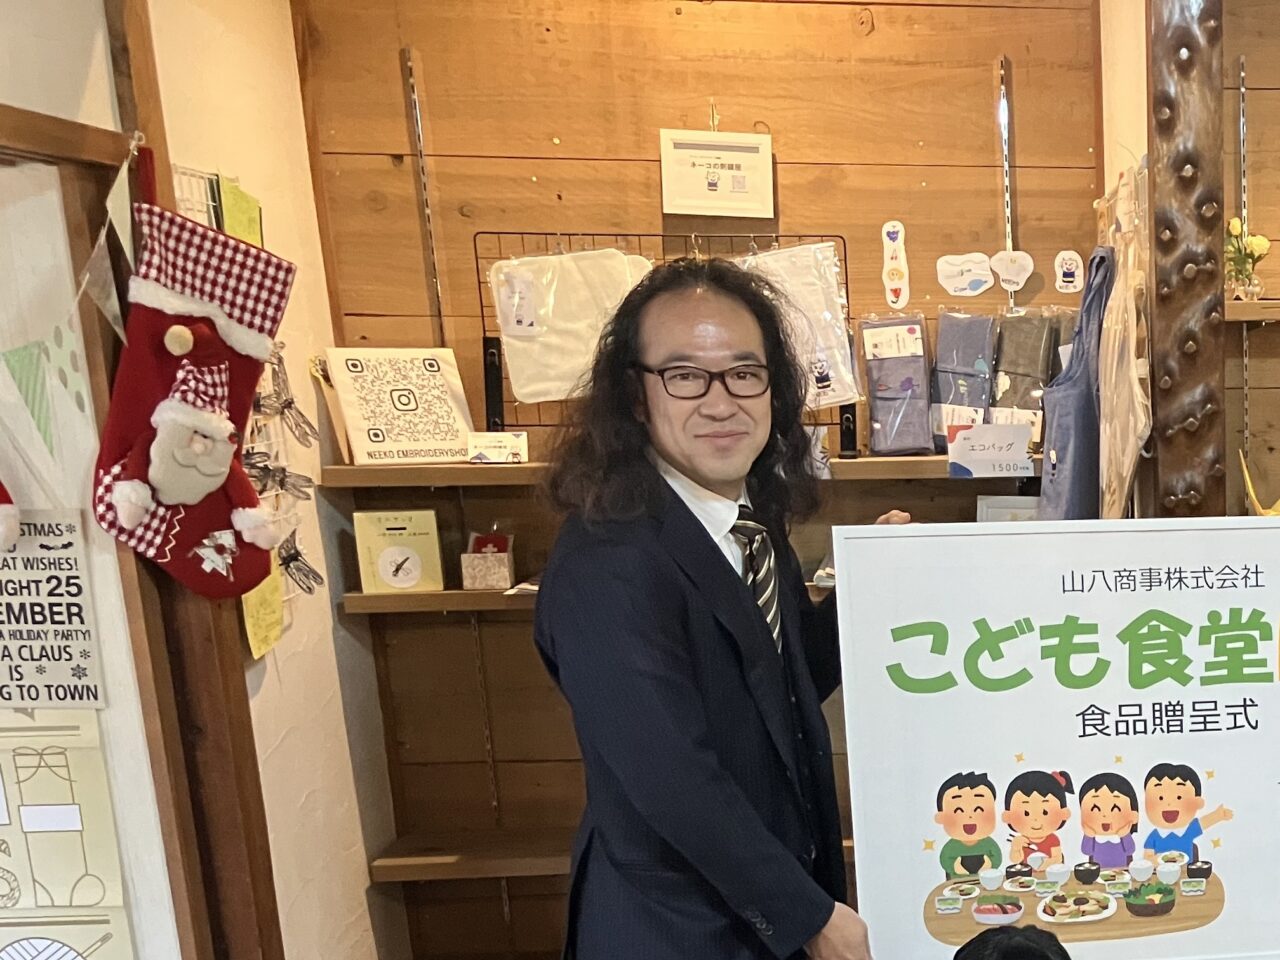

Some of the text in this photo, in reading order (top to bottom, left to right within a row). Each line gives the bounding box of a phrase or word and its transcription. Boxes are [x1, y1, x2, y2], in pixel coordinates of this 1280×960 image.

[366, 450, 395, 459] NEEKO
[397, 448, 469, 458] EMBROIDERYSHO
[969, 442, 1014, 452] エコバッグ
[22, 557, 79, 571] WISHES!
[46, 575, 83, 597] 25
[1062, 564, 1265, 594] 山八商事株式会社
[8, 629, 50, 641] HOLIDAY
[53, 629, 91, 641] PARTY!
[18, 645, 73, 661] CLAUS
[9, 665, 24, 681] IS
[16, 684, 40, 700] TO
[44, 684, 98, 701] TOWN
[1076, 698, 1259, 738] 食品贈呈式
